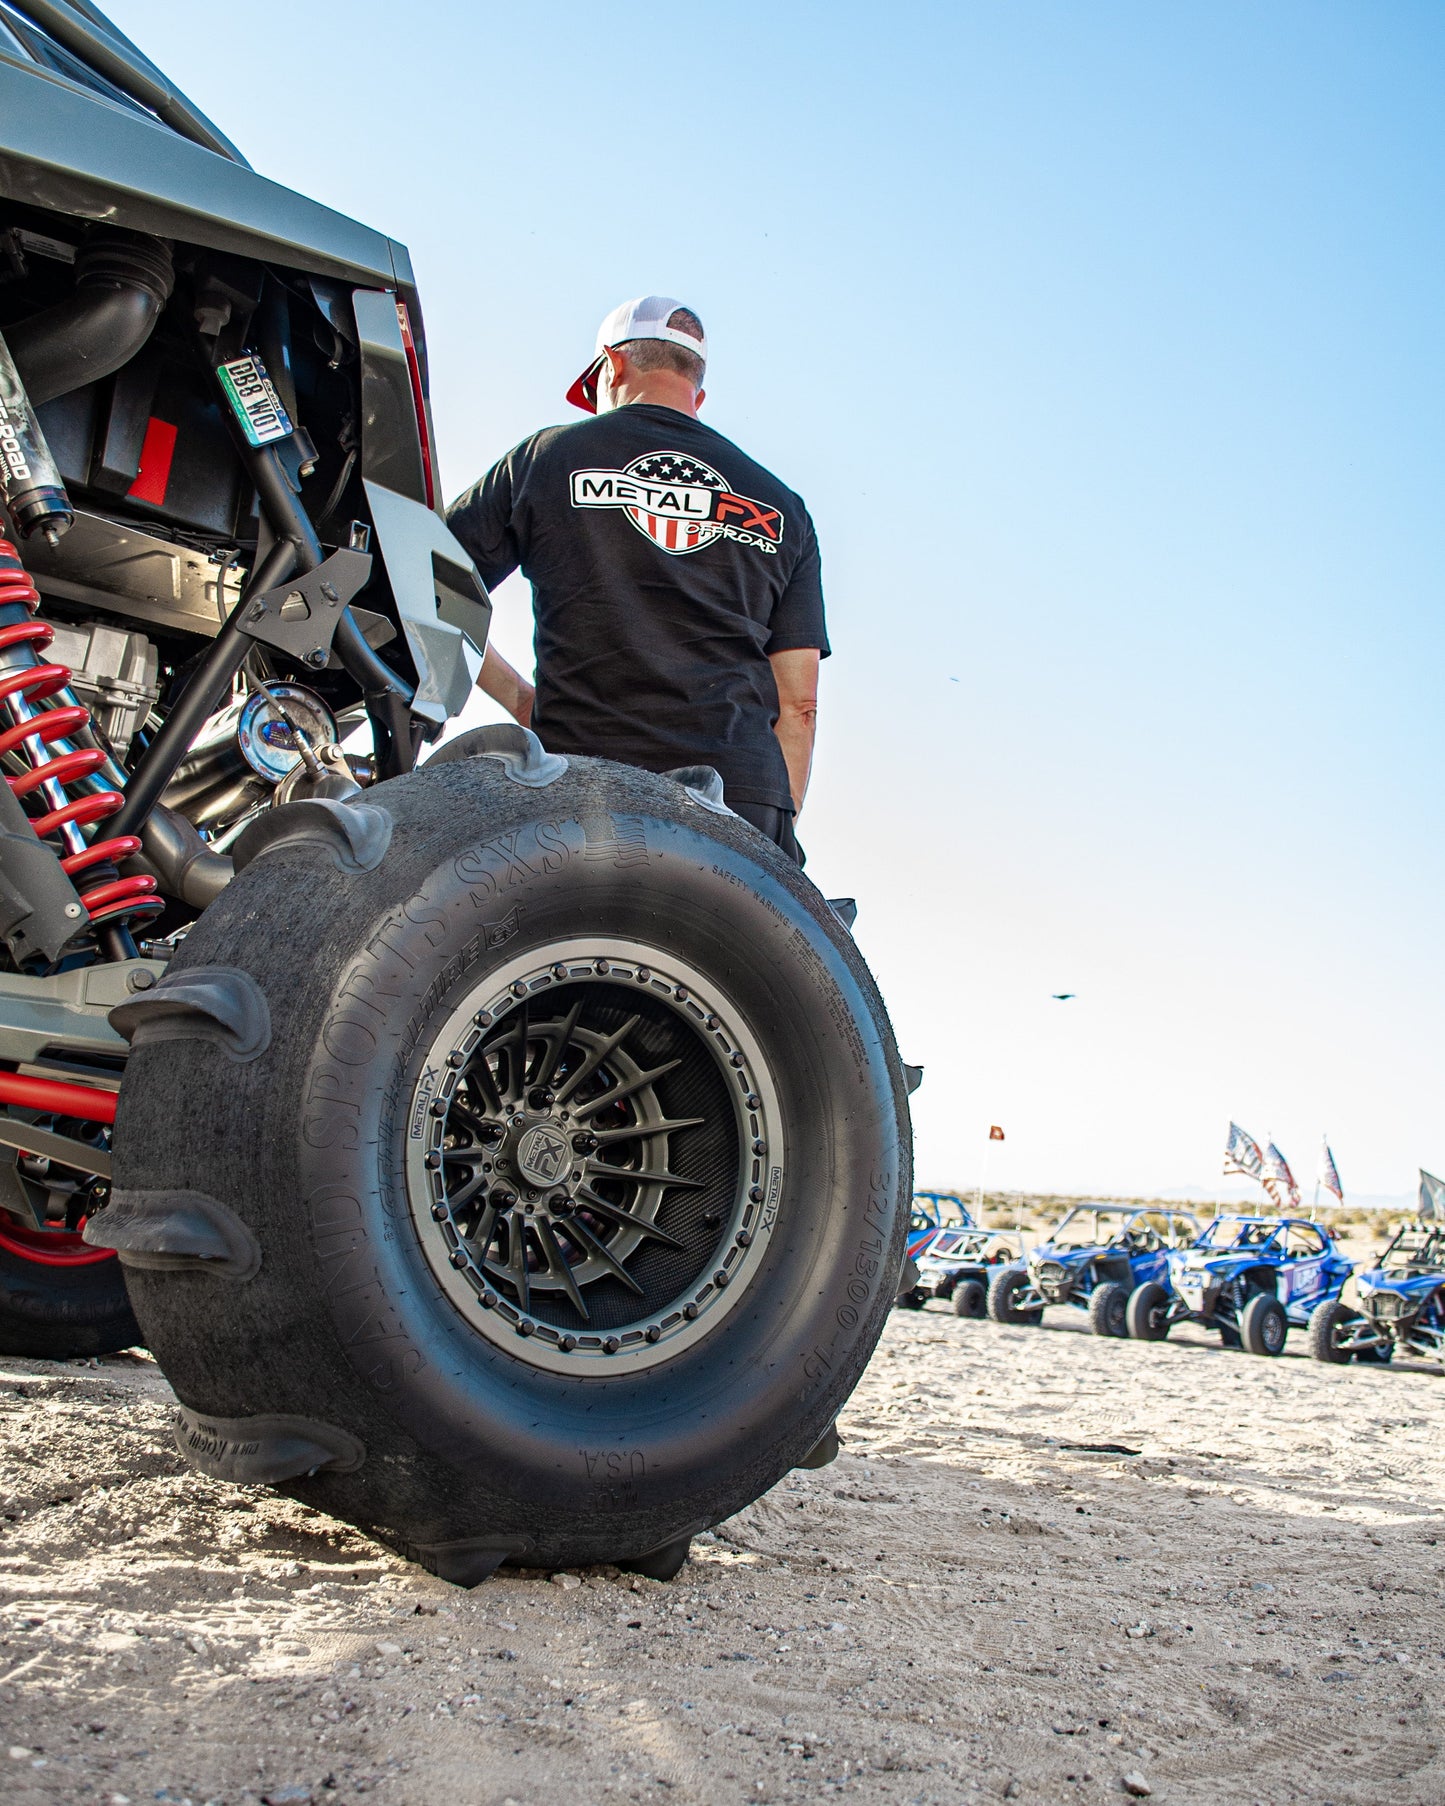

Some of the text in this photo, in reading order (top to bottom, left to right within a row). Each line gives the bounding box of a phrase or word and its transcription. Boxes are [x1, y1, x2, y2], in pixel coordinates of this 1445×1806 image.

[228, 361, 264, 398] DB8
[583, 479, 779, 539] METAL FX
[685, 522, 777, 555] OFFROAD
[711, 864, 793, 929] SAFETY WARNING:
[303, 890, 450, 1151] SPORTS
[453, 818, 571, 908] SXS
[417, 935, 481, 1019] TIRE
[413, 1065, 439, 1136] METAL FX
[526, 1135, 545, 1168] METAL
[534, 1138, 564, 1177] FX
[761, 1169, 780, 1234] METAL FX
